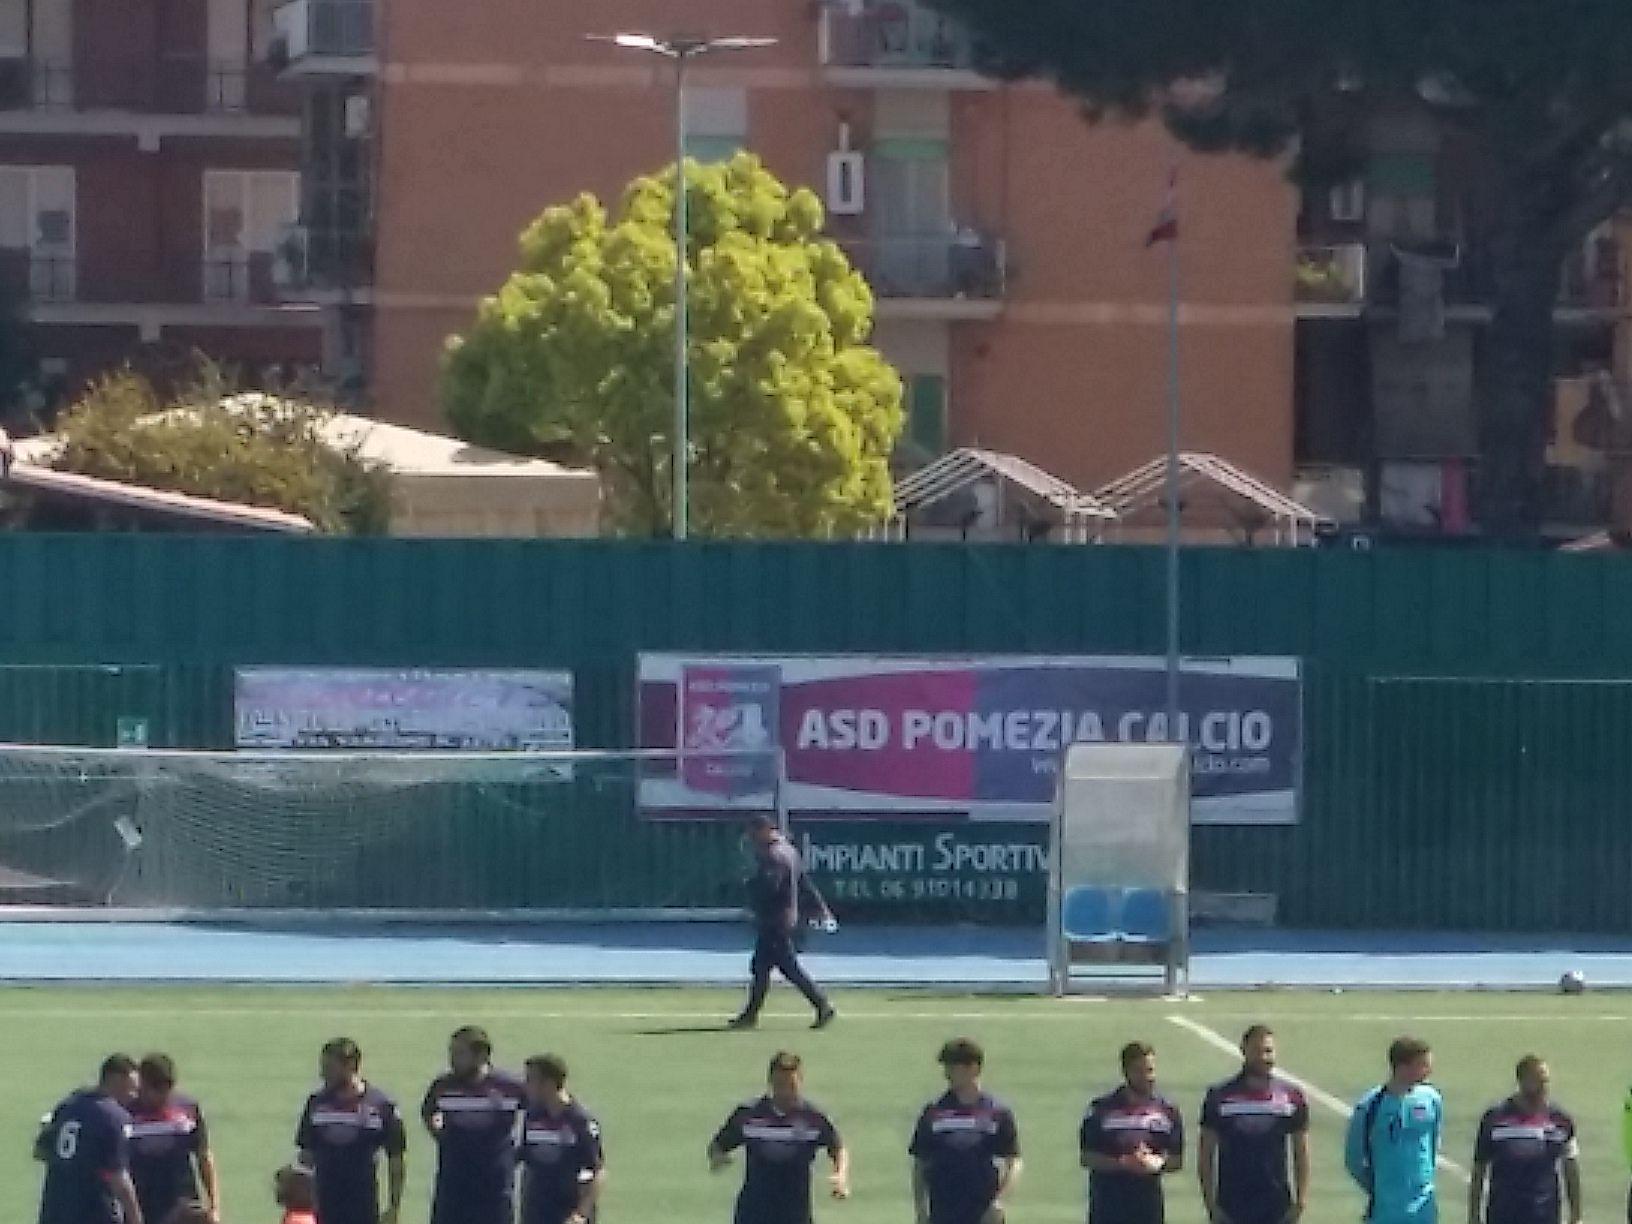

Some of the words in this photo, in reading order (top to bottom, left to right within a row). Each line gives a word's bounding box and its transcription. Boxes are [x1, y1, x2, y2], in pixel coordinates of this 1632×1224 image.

[797, 707, 889, 751] ASD
[901, 709, 1104, 751] POMEZIA
[1118, 709, 1272, 752] CALCIO
[803, 833, 924, 872] IMPIANTI
[56, 1120, 82, 1159] 6
